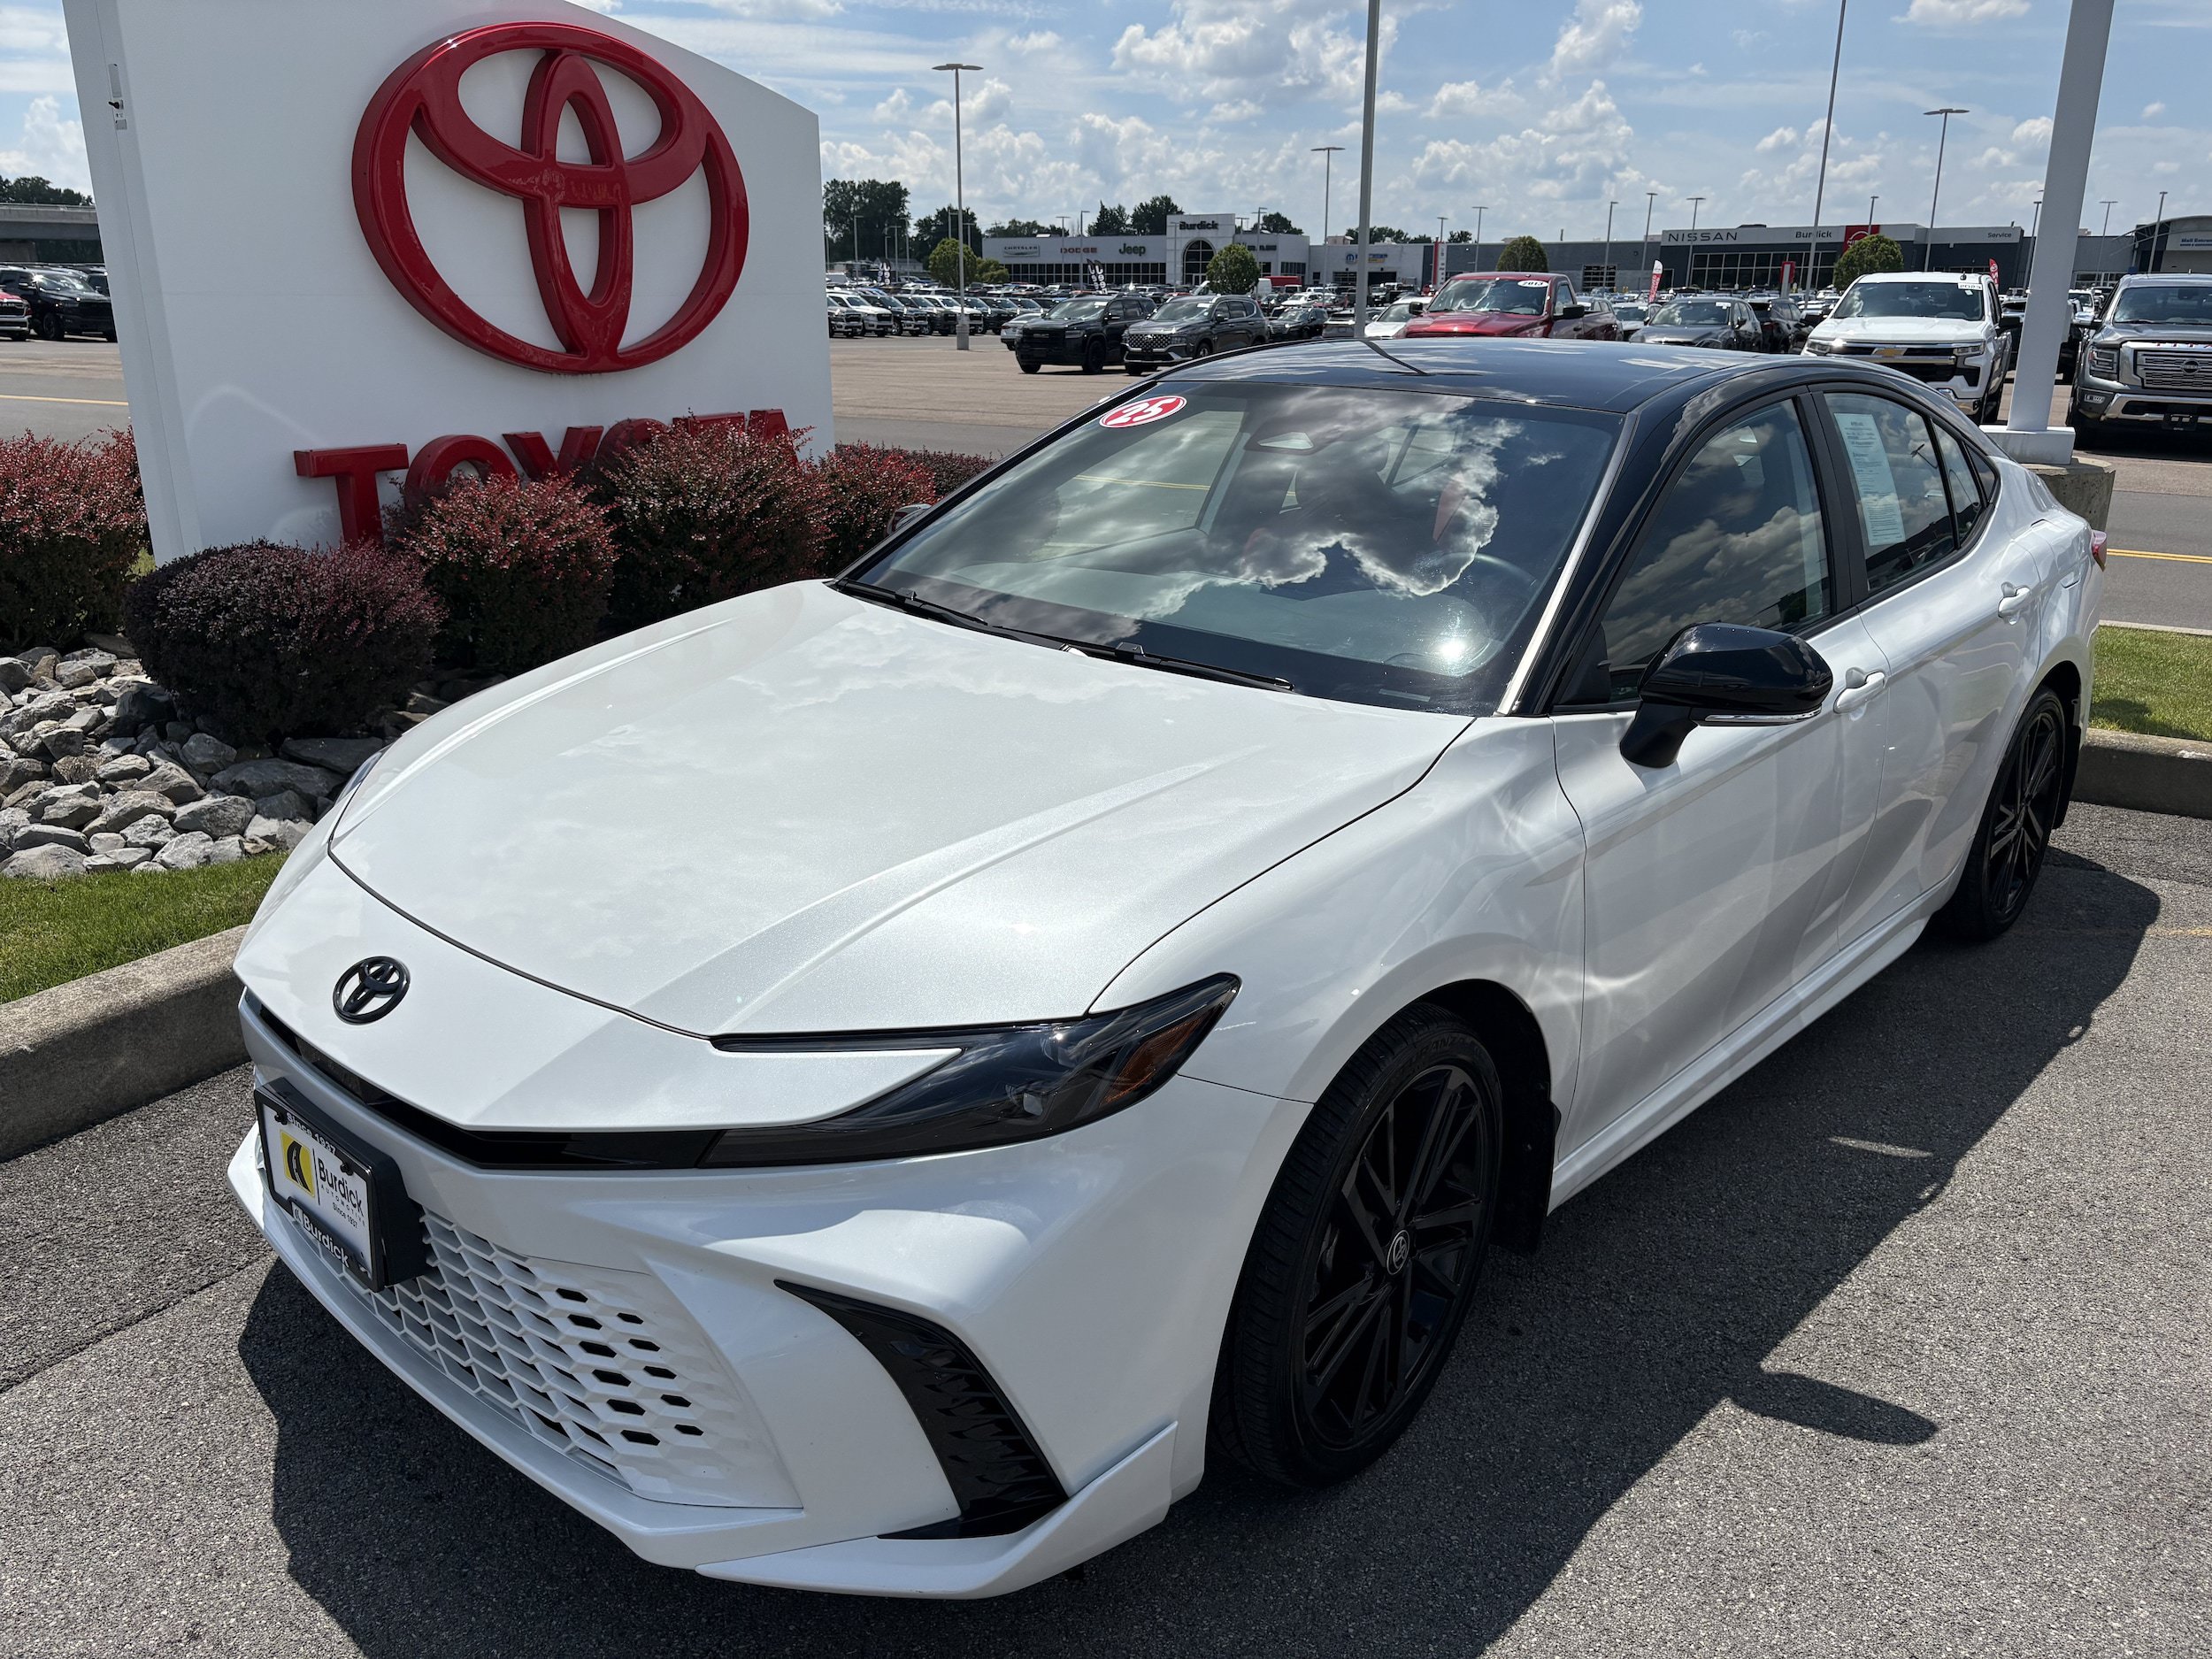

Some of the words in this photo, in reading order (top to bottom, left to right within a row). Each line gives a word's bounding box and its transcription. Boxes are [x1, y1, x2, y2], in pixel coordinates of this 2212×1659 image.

[1179, 220, 1218, 230] Burdick
[1668, 232, 1738, 242] NISSAN
[1118, 242, 1146, 257] Jeep
[1106, 397, 1178, 426] 25
[294, 408, 800, 549] TOY
[286, 1112, 313, 1136] Since
[314, 1133, 336, 1156] 1937
[318, 1156, 365, 1217] Burdick
[303, 1212, 349, 1268] Burdick
